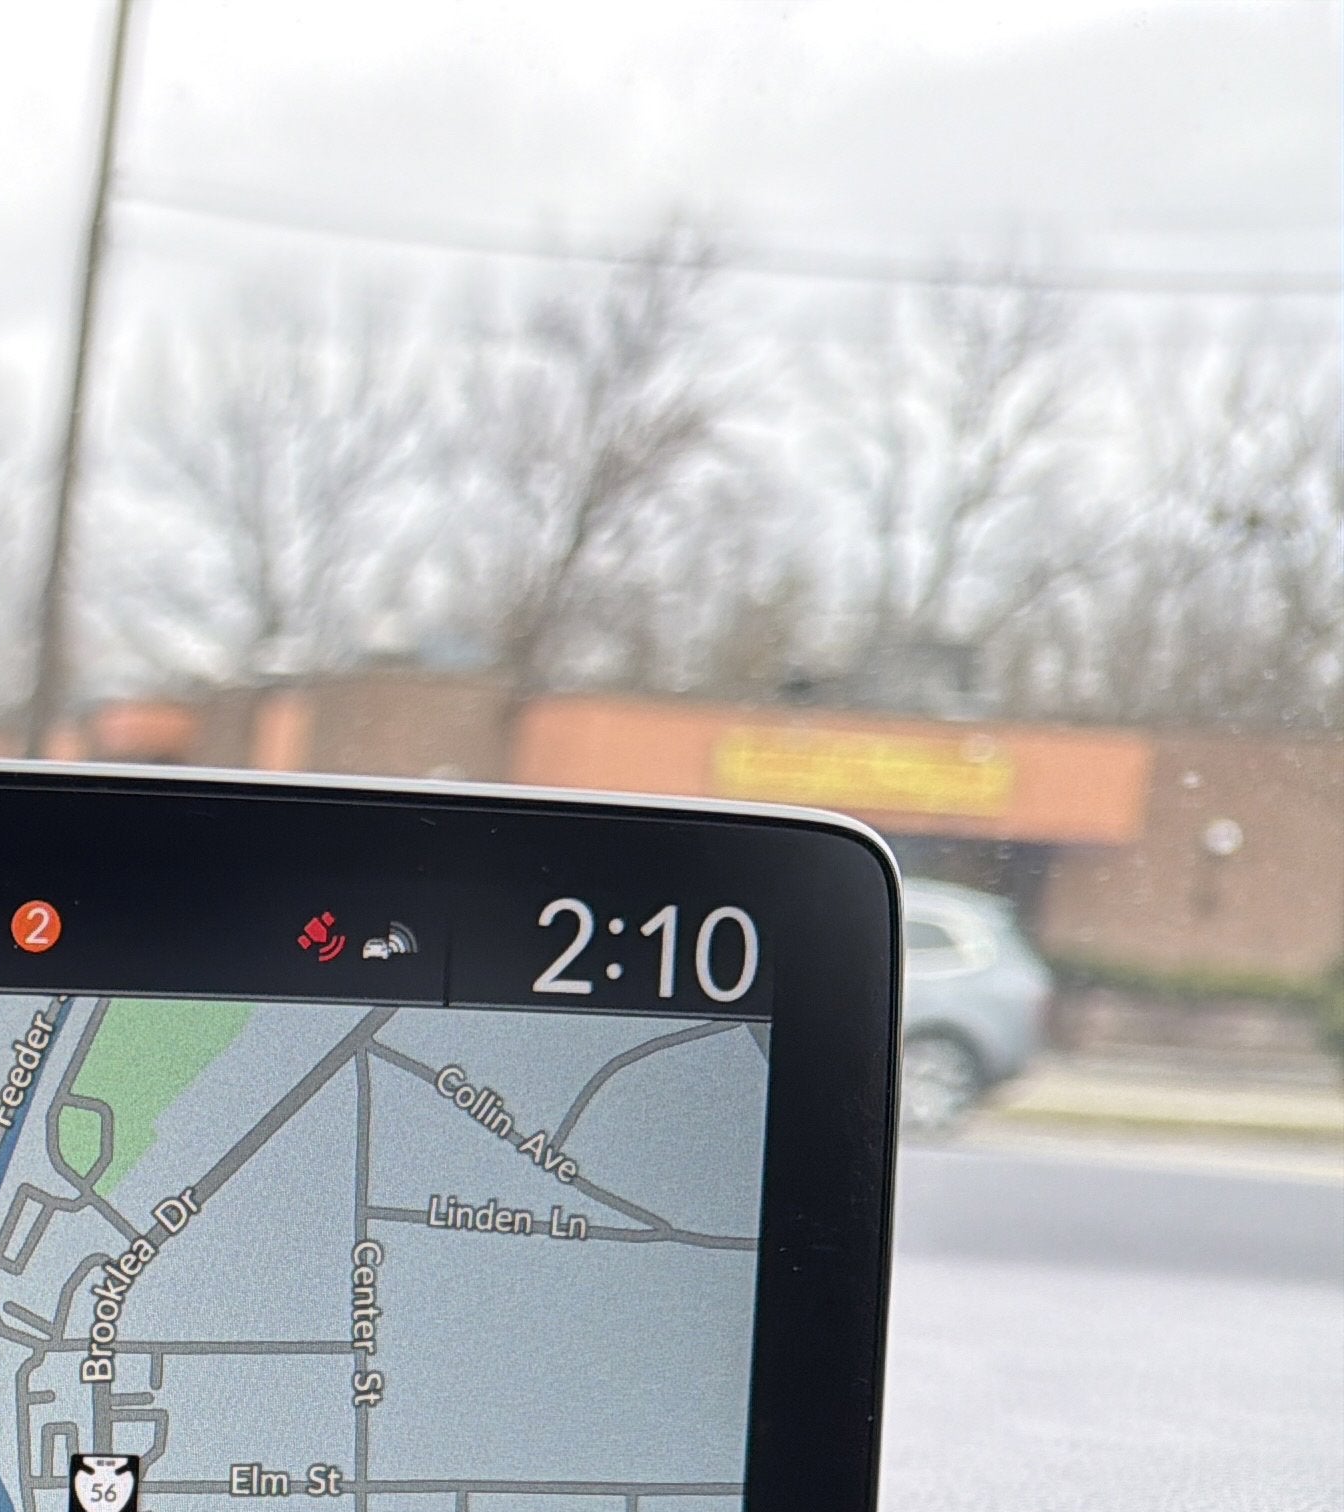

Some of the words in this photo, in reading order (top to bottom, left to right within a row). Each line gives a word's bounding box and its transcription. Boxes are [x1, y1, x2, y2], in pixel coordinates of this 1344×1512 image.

[24, 906, 51, 945] 2
[532, 898, 760, 1002] 2:10
[436, 1066, 513, 1138] Collin
[518, 1132, 577, 1183] Ave
[429, 1196, 533, 1234] Linden
[551, 1208, 587, 1241] Ln
[82, 1238, 156, 1382] Brooklea
[154, 1189, 198, 1233] Dr
[353, 1241, 383, 1354] Center
[353, 1372, 383, 1406] St
[90, 1482, 117, 1502] 56
[231, 1464, 289, 1495] Elm
[307, 1465, 342, 1495] St
